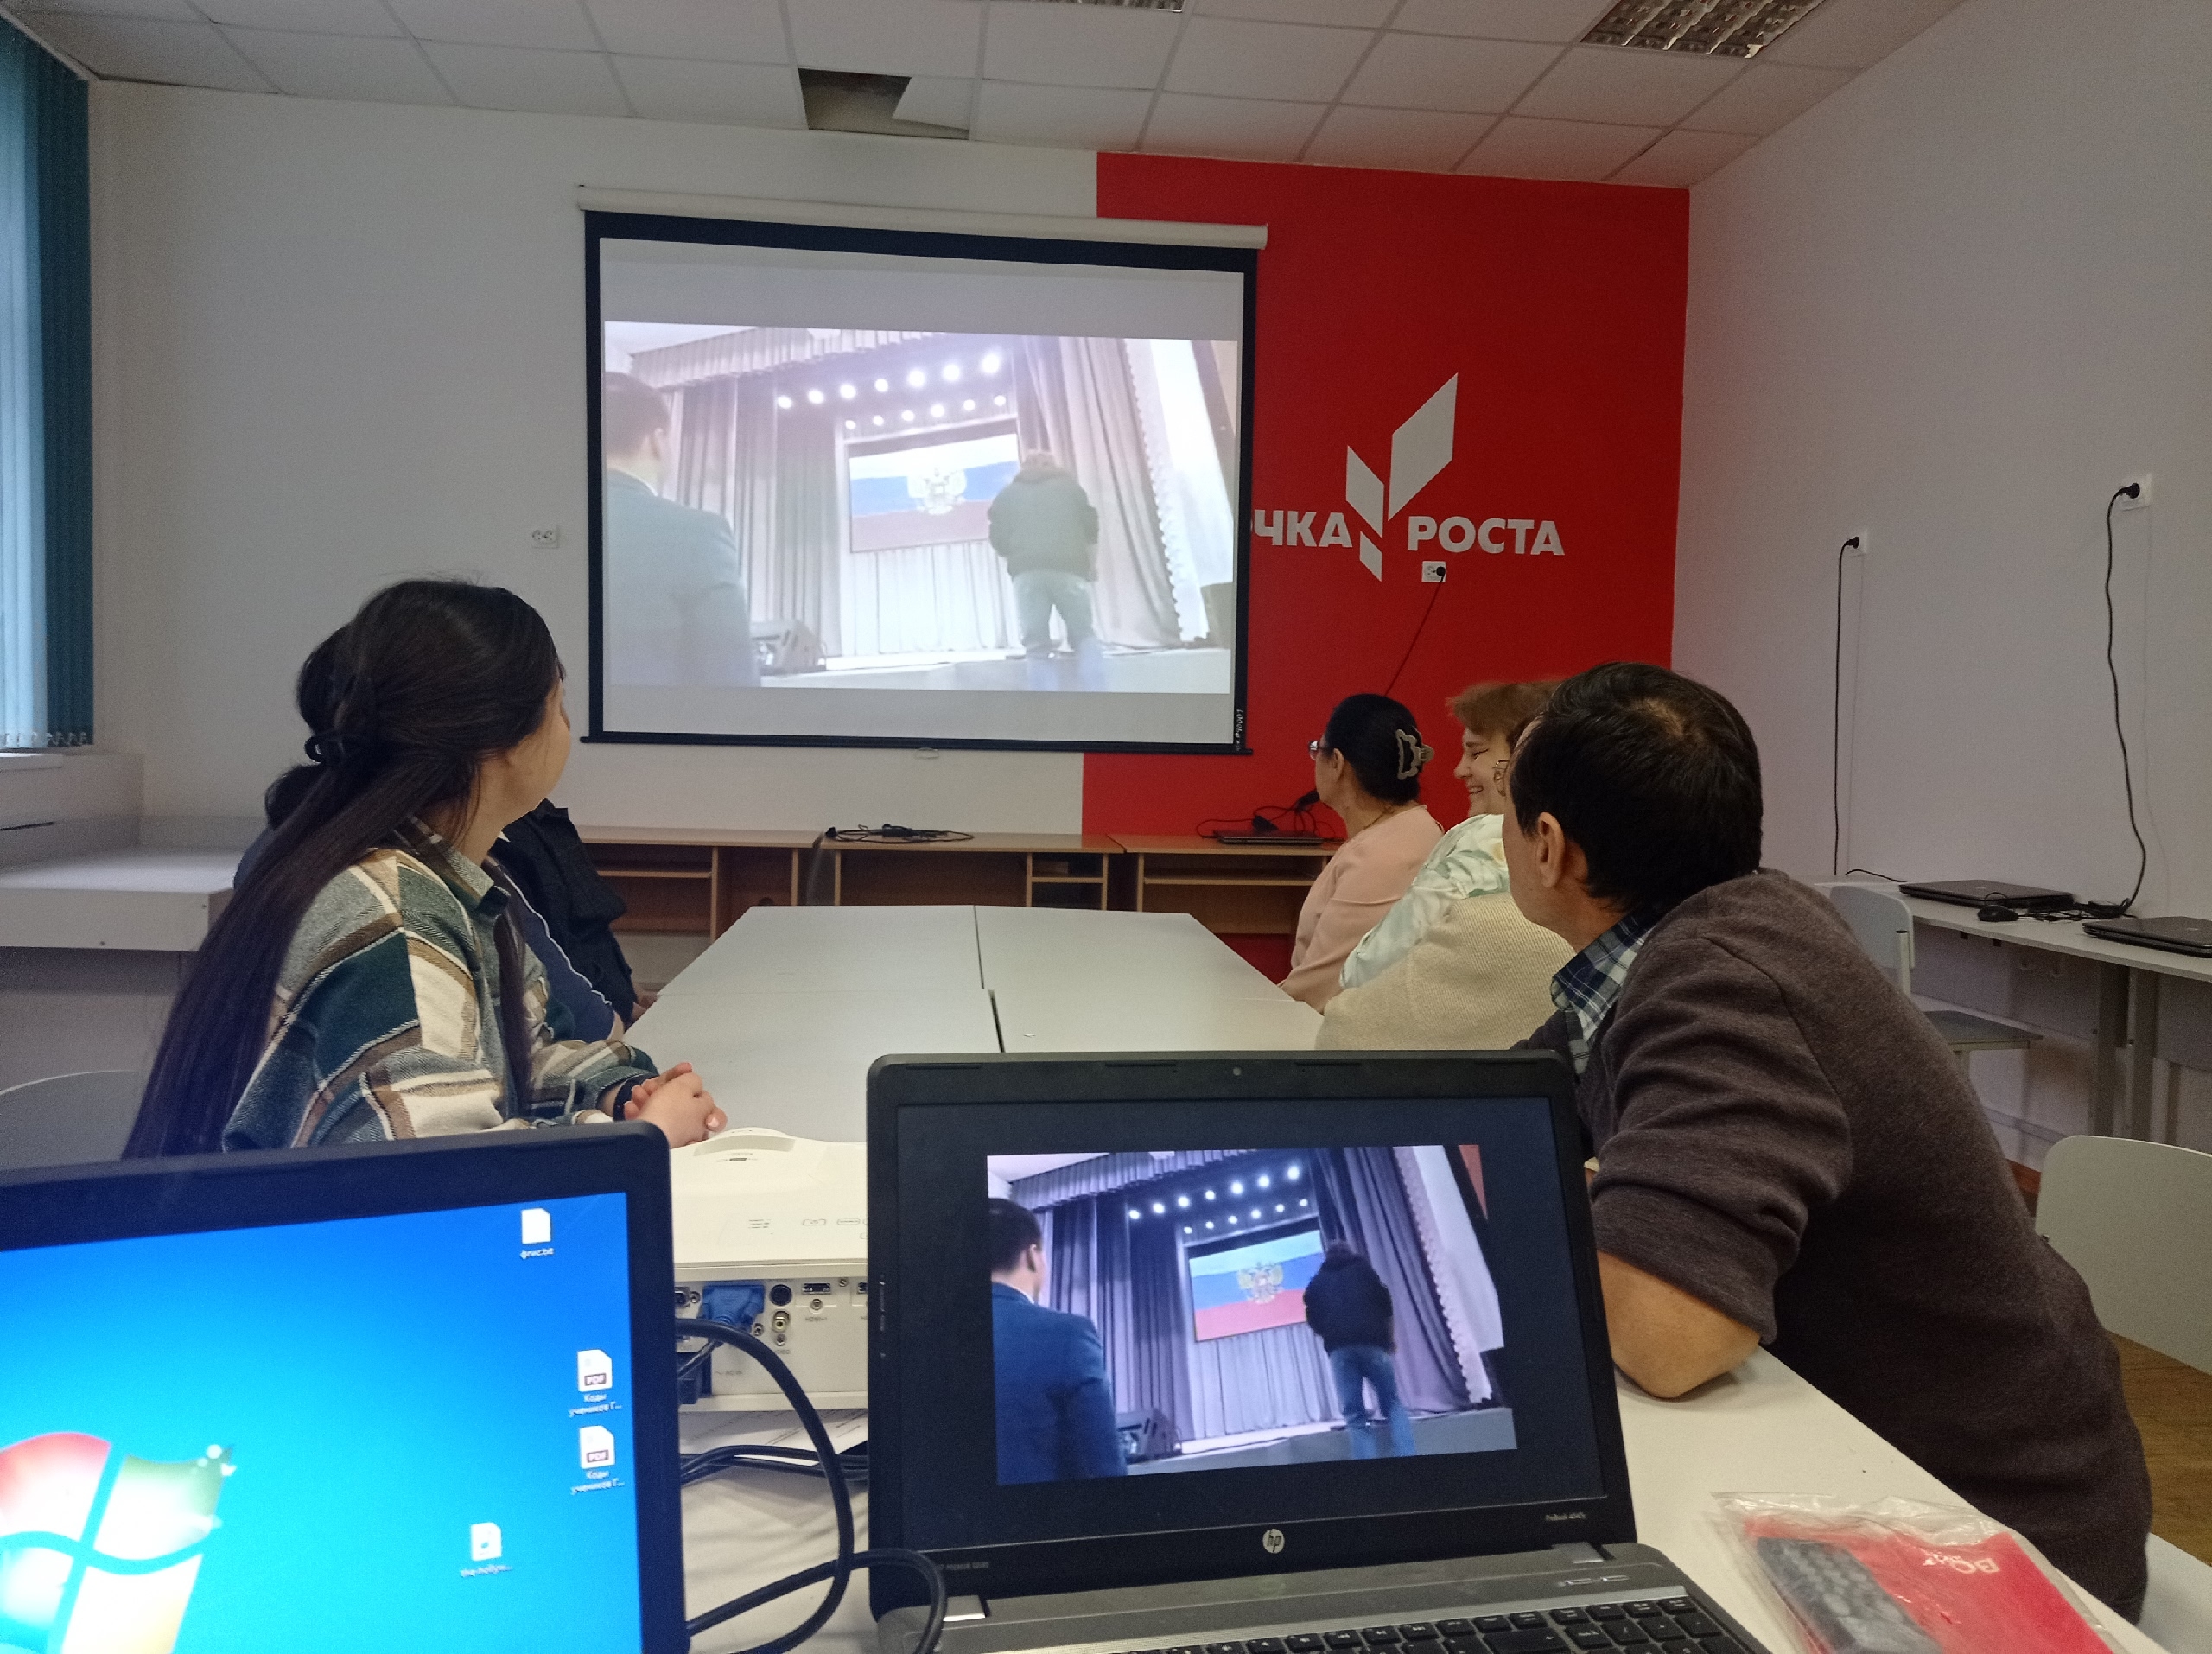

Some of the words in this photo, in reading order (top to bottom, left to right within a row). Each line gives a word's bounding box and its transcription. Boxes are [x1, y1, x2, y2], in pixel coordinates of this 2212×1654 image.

[1252, 509, 1353, 548] ЧКА
[1407, 515, 1565, 556] РОСТА
[585, 1374, 607, 1386] PDF
[587, 1450, 609, 1463] PDF
[1266, 1530, 1282, 1553] hp
